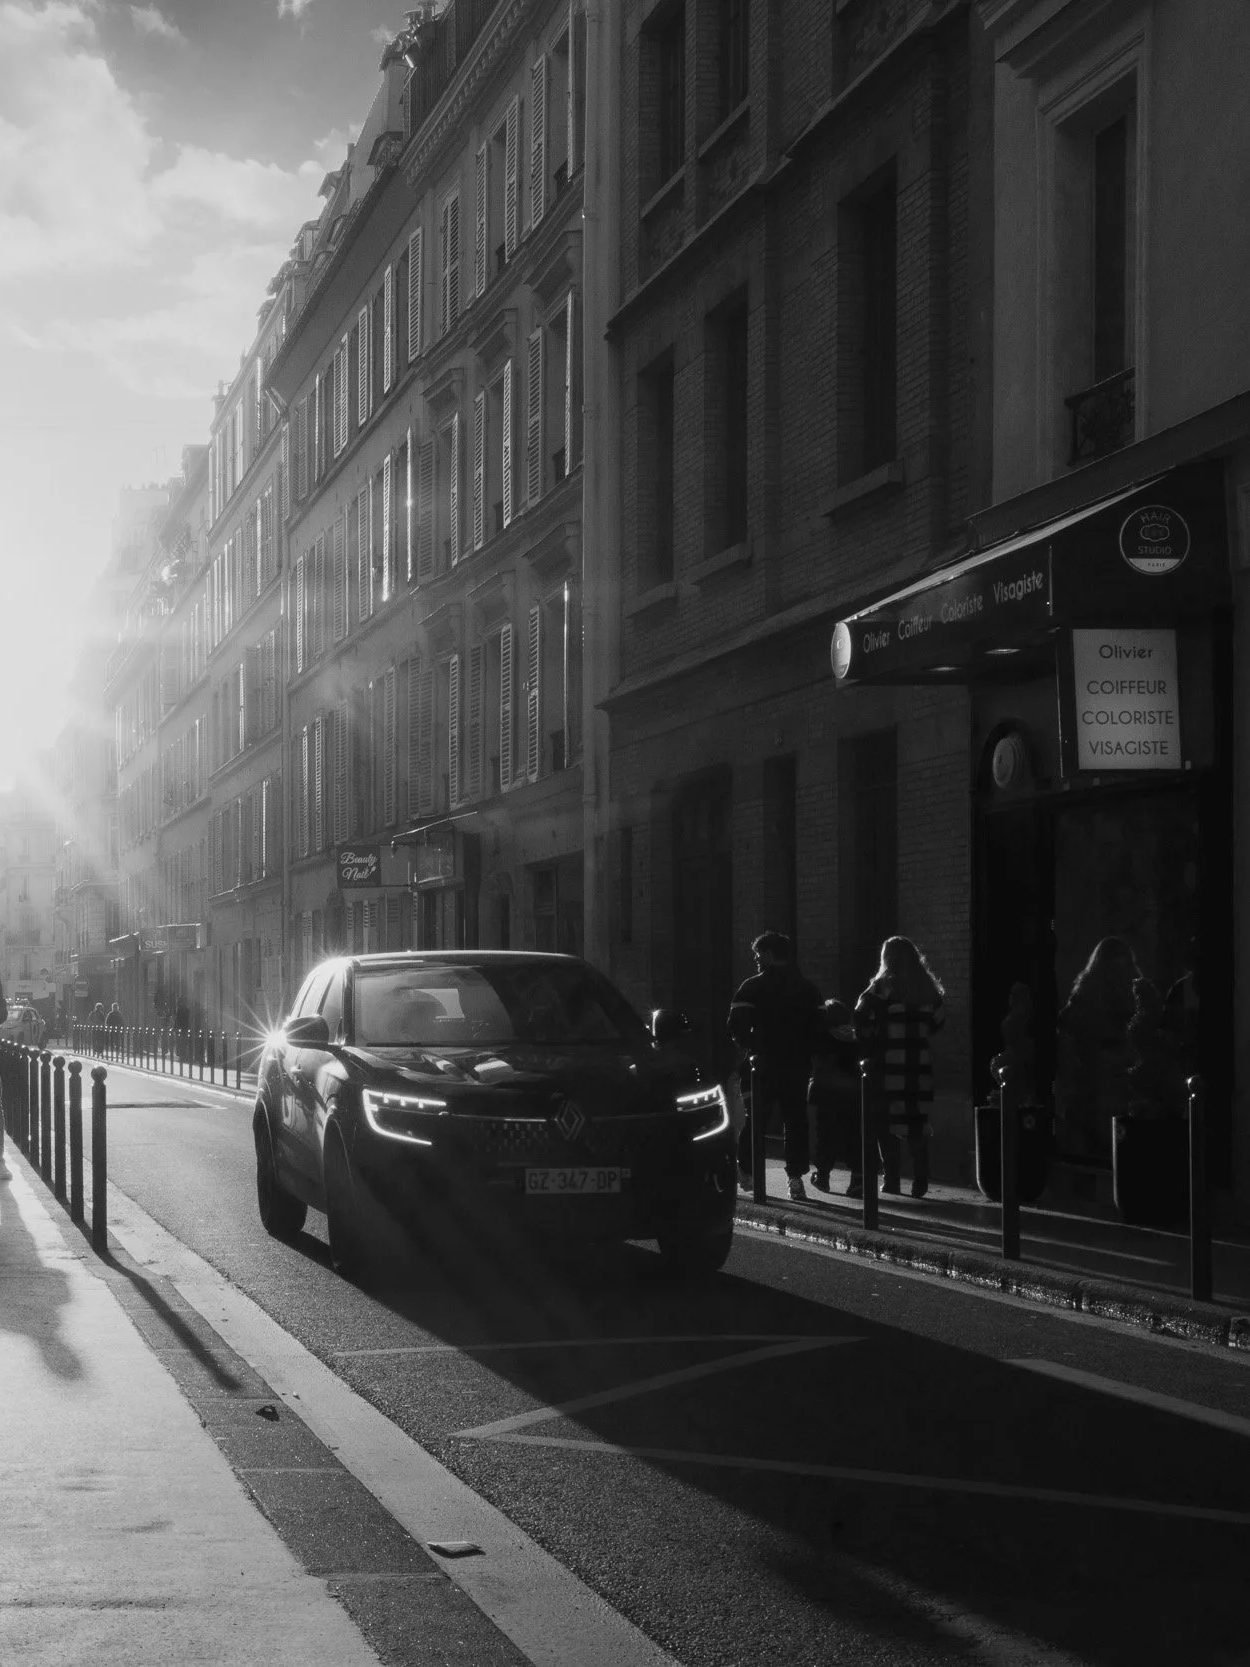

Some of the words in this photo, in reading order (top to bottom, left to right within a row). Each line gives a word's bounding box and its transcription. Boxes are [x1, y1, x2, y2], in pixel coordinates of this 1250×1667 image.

[1140, 511, 1171, 524] HAIR
[1138, 546, 1172, 555] STUDIO
[863, 630, 890, 654] Olivier
[898, 615, 933, 641] Coiffeur
[941, 594, 984, 624] Coloriste
[993, 571, 1044, 604] Visagiste
[1099, 644, 1154, 659] Olivier
[1087, 680, 1167, 695] COIFFEUR
[1082, 710, 1174, 725] COLORISTE
[1088, 740, 1169, 755] VISAGISTE
[340, 851, 377, 867] Beauty
